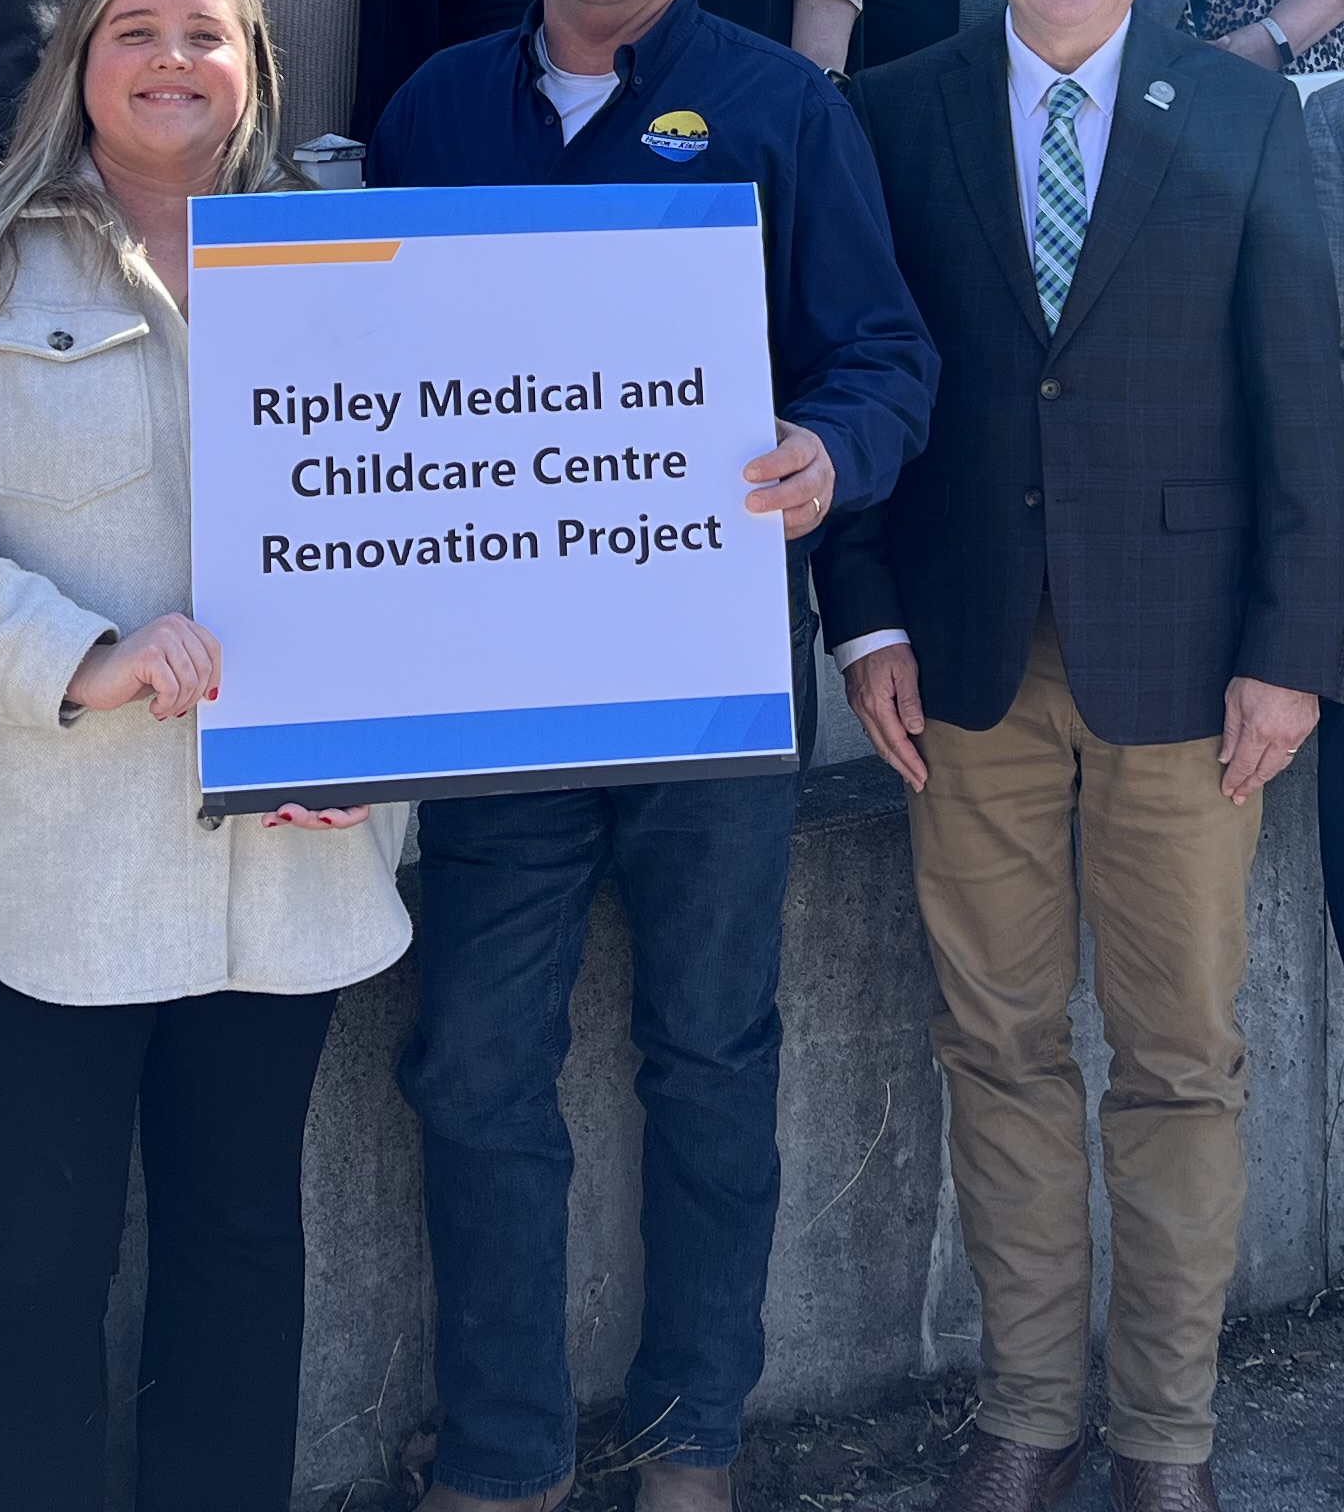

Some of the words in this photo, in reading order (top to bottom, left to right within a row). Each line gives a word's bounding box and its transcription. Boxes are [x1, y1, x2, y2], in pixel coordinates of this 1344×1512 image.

[252, 382, 402, 435] Ripley
[419, 371, 603, 419] Medical
[619, 366, 705, 409] and
[291, 451, 517, 498] Childcare
[532, 445, 688, 486] Centre
[262, 522, 540, 574] Renovation
[557, 513, 724, 565] Project
